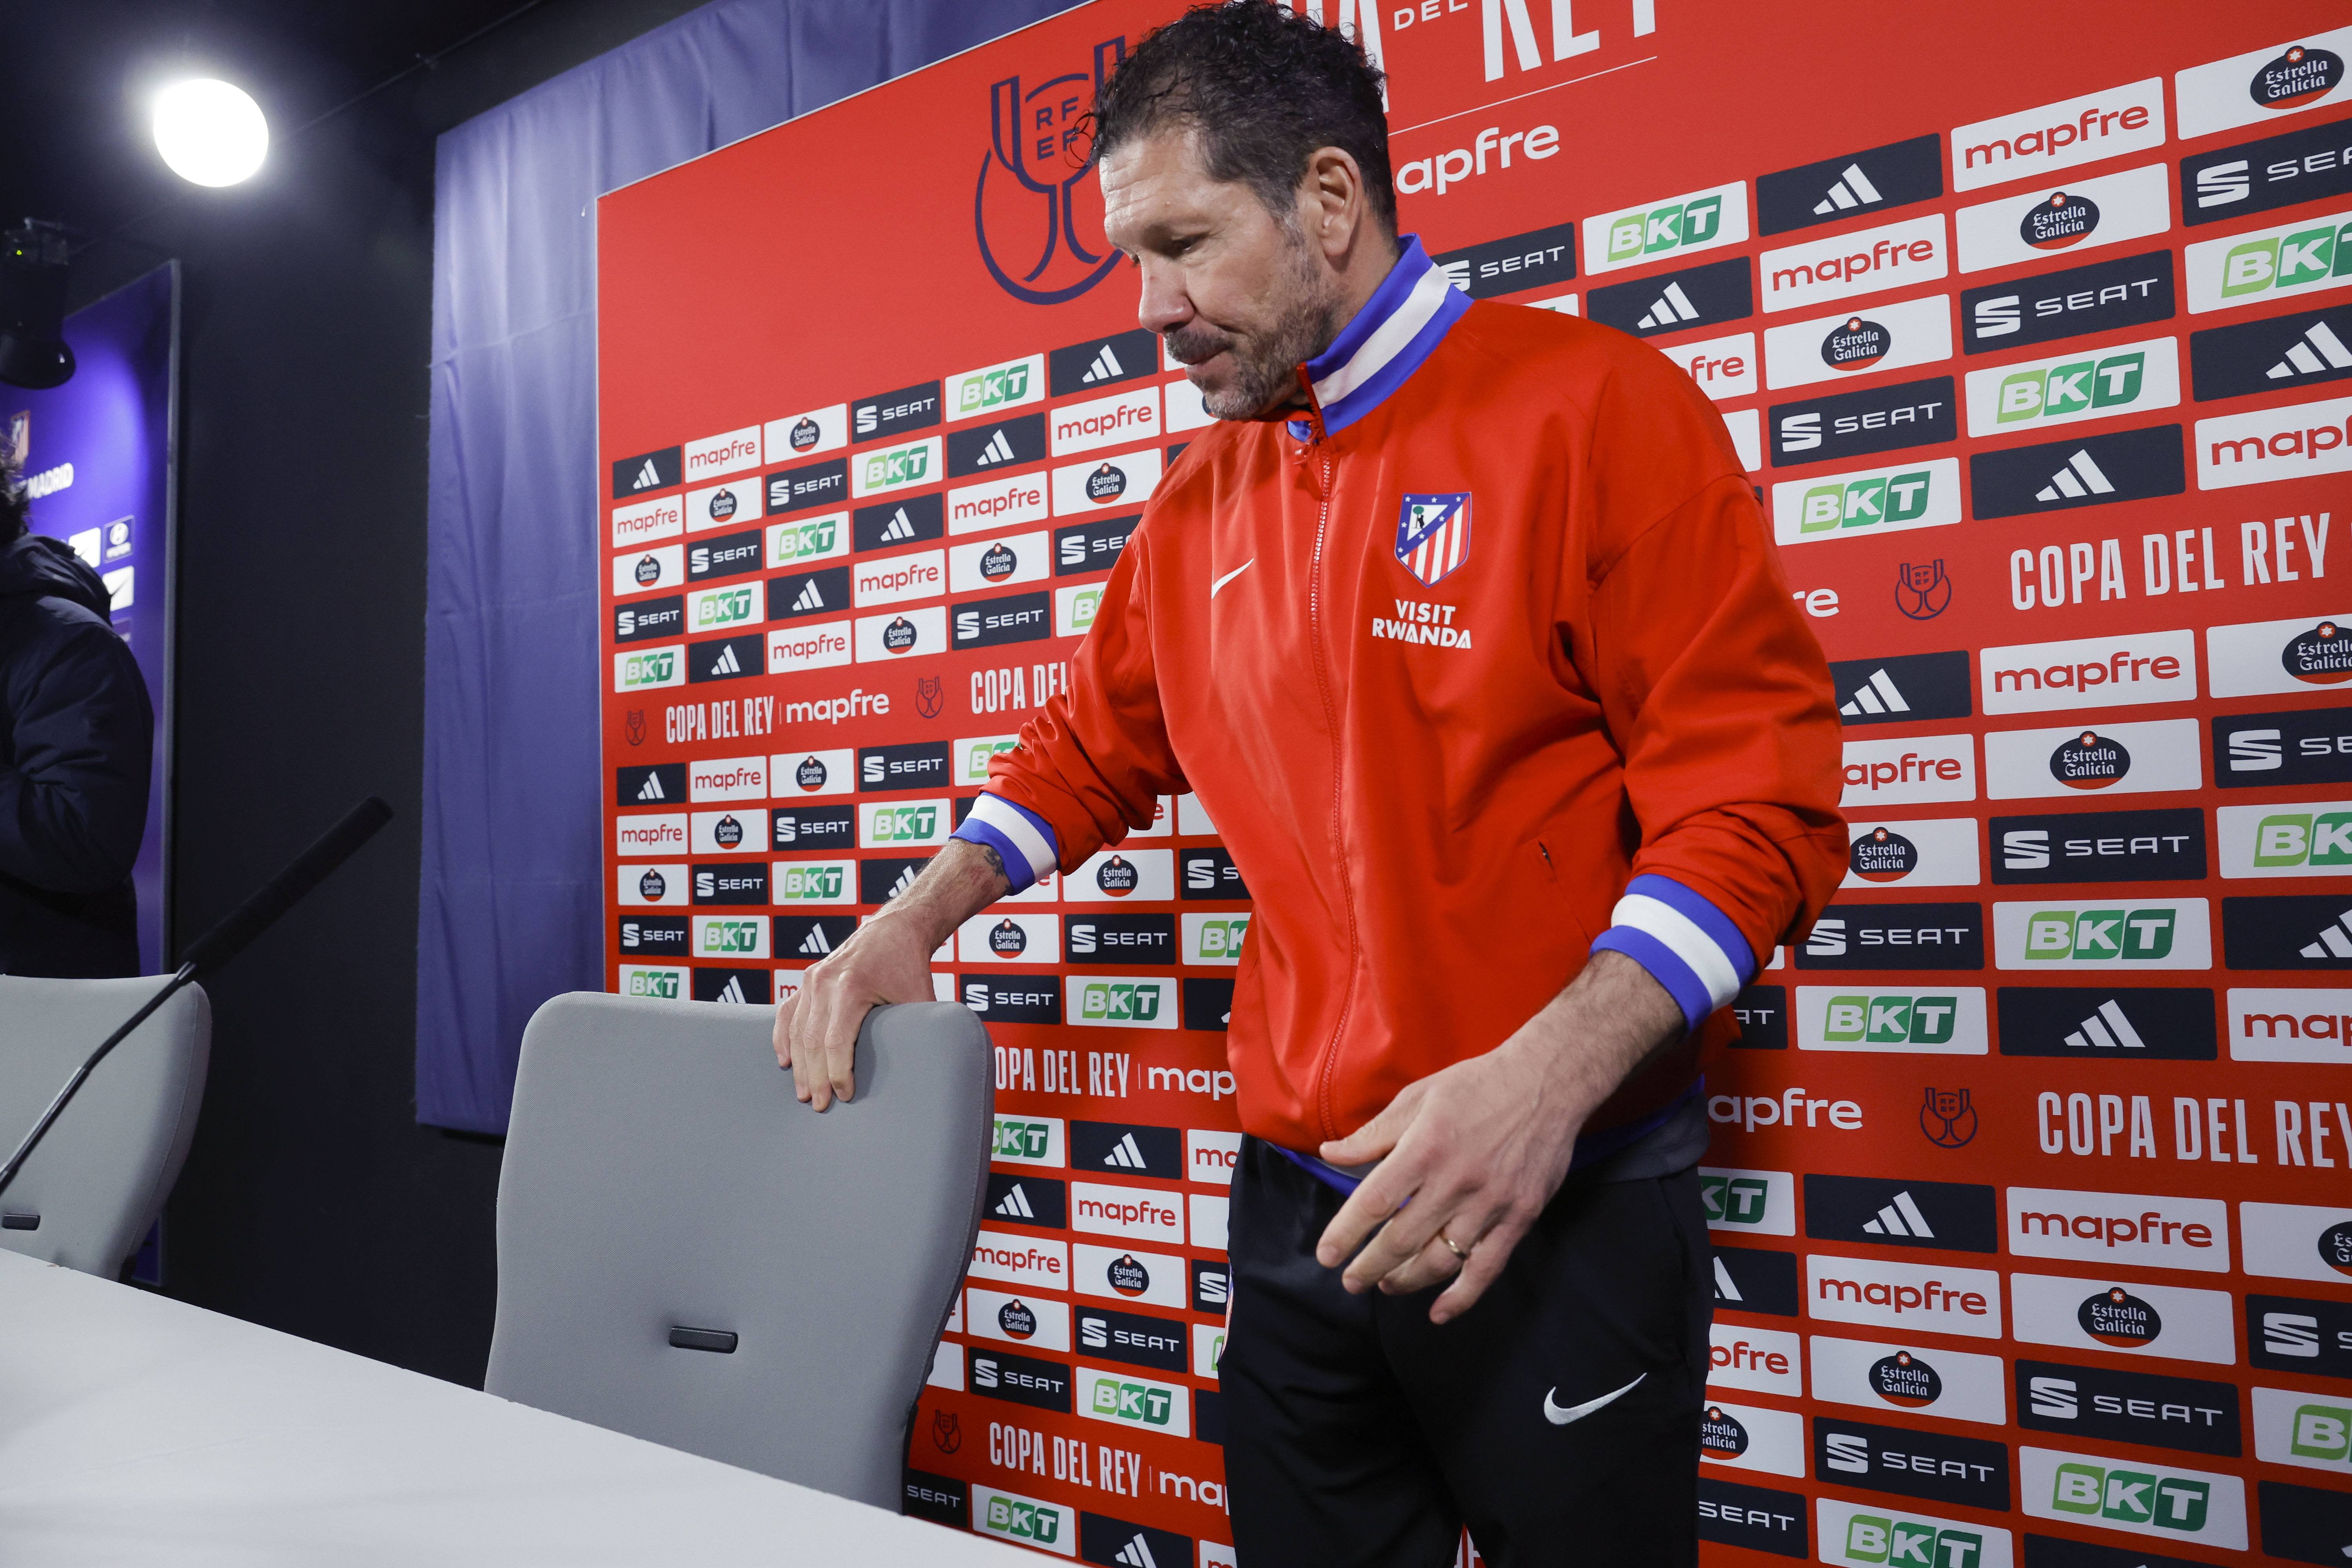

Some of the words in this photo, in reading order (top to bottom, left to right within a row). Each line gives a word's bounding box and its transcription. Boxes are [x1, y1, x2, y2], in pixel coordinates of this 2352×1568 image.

[2265, 60, 2327, 86] Estrella
[2268, 75, 2325, 98] Galicia
[1966, 107, 2149, 169] mapfre
[1397, 125, 1559, 195] apfre
[2267, 147, 2352, 181] SE
[1610, 201, 1719, 256] BKT
[2033, 206, 2087, 226] Estrella
[2034, 219, 2085, 239] Galicia
[1480, 246, 1564, 278] SEAT
[1773, 240, 1933, 291] mapfre
[2224, 229, 2352, 292] BK
[2036, 278, 2158, 316] SEAT
[1831, 330, 1880, 349] Estrella
[1835, 343, 1877, 360] Galicia
[1682, 355, 1744, 381] fre
[963, 368, 1027, 407] BKT
[2000, 358, 2141, 417] BKT
[883, 398, 935, 420] SEAT
[1835, 403, 1942, 434] SEAT
[1058, 405, 1151, 439] mapfre
[2211, 414, 2352, 466] map
[691, 441, 755, 468] mapfre
[867, 450, 926, 485] BKT
[1092, 473, 1120, 487] Estrella
[794, 475, 842, 494] SEAT
[1092, 483, 1120, 496] Galicia
[955, 488, 1040, 519] mapfre
[1804, 477, 1927, 528] BKT
[618, 509, 677, 533] mapfre
[780, 524, 834, 556] BKT
[1093, 536, 1123, 552] SE
[713, 545, 757, 563] SEAT
[984, 552, 1012, 566] Estrella
[2011, 539, 2126, 610] COPA
[2143, 527, 2224, 596] DEL
[2241, 513, 2330, 585] REY
[861, 564, 938, 592] mapfre
[985, 561, 1011, 576] Galicia
[639, 610, 679, 626] SEAT
[701, 592, 750, 622] BKT
[986, 610, 1043, 628] SEAT
[1396, 599, 1455, 624] VISIT
[887, 627, 912, 638] Estrella
[888, 636, 911, 647] Galicia
[1372, 618, 1471, 649] RWANDA
[774, 635, 845, 659] mapfre
[627, 655, 672, 682] BKT
[1995, 652, 2180, 692] mapfre
[971, 666, 1025, 714] COPA
[666, 704, 706, 743] COPA
[712, 700, 739, 739] DEL
[744, 696, 773, 735] REY
[787, 689, 889, 724] mapfre
[890, 759, 943, 773] SEAT
[2063, 748, 2116, 765] Estrella
[2065, 762, 2114, 776] Galicia
[696, 768, 760, 790] mapfre
[800, 765, 824, 777] Estrella
[801, 775, 822, 785] Galicia
[1844, 753, 1962, 790] apfre
[622, 824, 682, 845] mapfre
[801, 821, 849, 833] SEAT
[874, 810, 934, 838] BKT
[1858, 844, 1905, 859] Estrella
[2065, 836, 2189, 856] SEAT
[2255, 817, 2352, 863] BK
[1102, 867, 1132, 878] Estrella
[1859, 856, 1904, 870] Galicia
[719, 879, 763, 889] SEAT
[786, 869, 841, 896] BKT
[1103, 877, 1131, 888] Galicia
[644, 931, 684, 940] SEAT
[705, 924, 755, 949] BKT
[995, 931, 1020, 942] Estrella
[995, 940, 1020, 950] Galicia
[1104, 933, 1167, 945] SEAT
[1200, 924, 1249, 955] BK
[1860, 929, 1969, 944] SEAT
[2028, 913, 2171, 955] BKT
[631, 974, 678, 999] BKT
[995, 993, 1053, 1005] SEAT
[1084, 987, 1157, 1017] BKT
[1736, 1010, 1774, 1024] AT
[1827, 1000, 1952, 1039] BKT
[996, 1047, 1035, 1091] OPA
[1043, 1049, 1082, 1094] DEL
[1089, 1051, 1130, 1098] REY
[1148, 1066, 1236, 1101] map
[1708, 1088, 1862, 1132] apfre
[2038, 1092, 2156, 1158] COPA
[2174, 1097, 2258, 1163] DEL
[1079, 1200, 1175, 1226] mapfre
[2021, 1212, 2212, 1247] mapfre
[973, 1246, 1061, 1274] mapfre
[1114, 1265, 1142, 1280] Estrella
[1114, 1274, 1142, 1289] Galicia
[1820, 1279, 1987, 1315] mapfre
[1003, 1308, 1031, 1323] Estrella
[1005, 1319, 1030, 1332] Galicia
[2092, 1303, 2147, 1323] Estrella
[2093, 1317, 2145, 1336] Galicia
[1114, 1331, 1179, 1351] SEAT
[1710, 1341, 1789, 1374] pfre
[1005, 1372, 1063, 1392] SEAT
[1881, 1366, 1929, 1385] Estrella
[1882, 1379, 1928, 1397] Galicia
[1094, 1382, 1169, 1420] BKT
[2094, 1396, 2222, 1425] SEAT
[1702, 1423, 1737, 1437] strella
[990, 1423, 1045, 1475] COPA
[1054, 1436, 1092, 1486] DEL
[1100, 1446, 1140, 1497] REY
[1882, 1452, 1994, 1481] SEAT
[907, 1485, 960, 1508] SEAT
[2055, 1469, 2200, 1524] BKT
[989, 1501, 1056, 1537] BKT
[1698, 1501, 1795, 1531] SEAT
[1847, 1519, 1980, 1568] BKT
